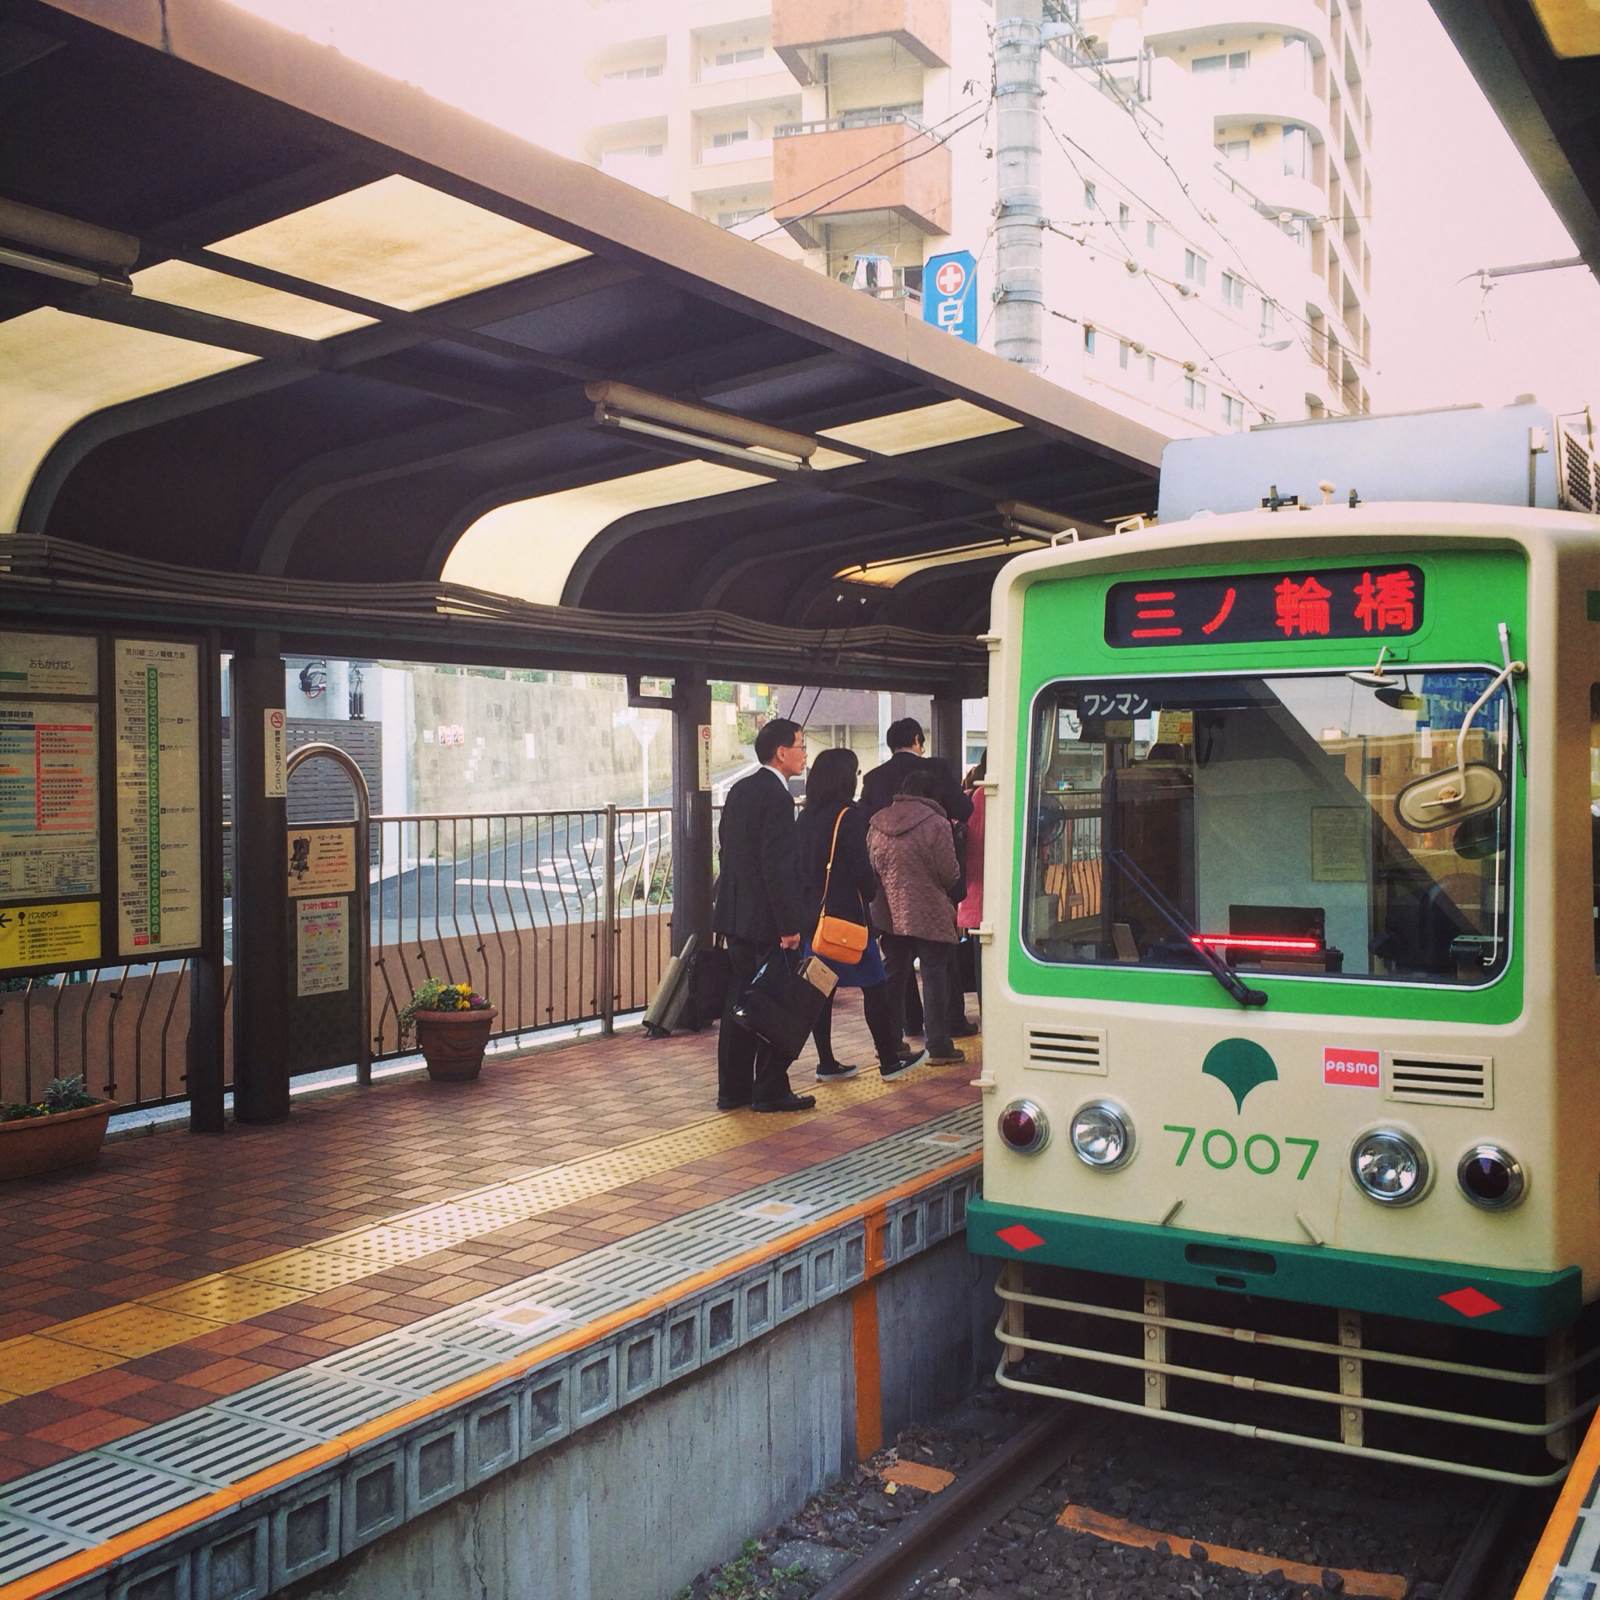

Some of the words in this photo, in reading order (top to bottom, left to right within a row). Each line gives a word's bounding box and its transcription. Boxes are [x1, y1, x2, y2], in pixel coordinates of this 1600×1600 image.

[1131, 569, 1416, 638] 三ノ輪橋
[1083, 693, 1149, 716] ワンマン
[1325, 1060, 1378, 1075] PASMO
[1163, 1124, 1320, 1181] 7007
